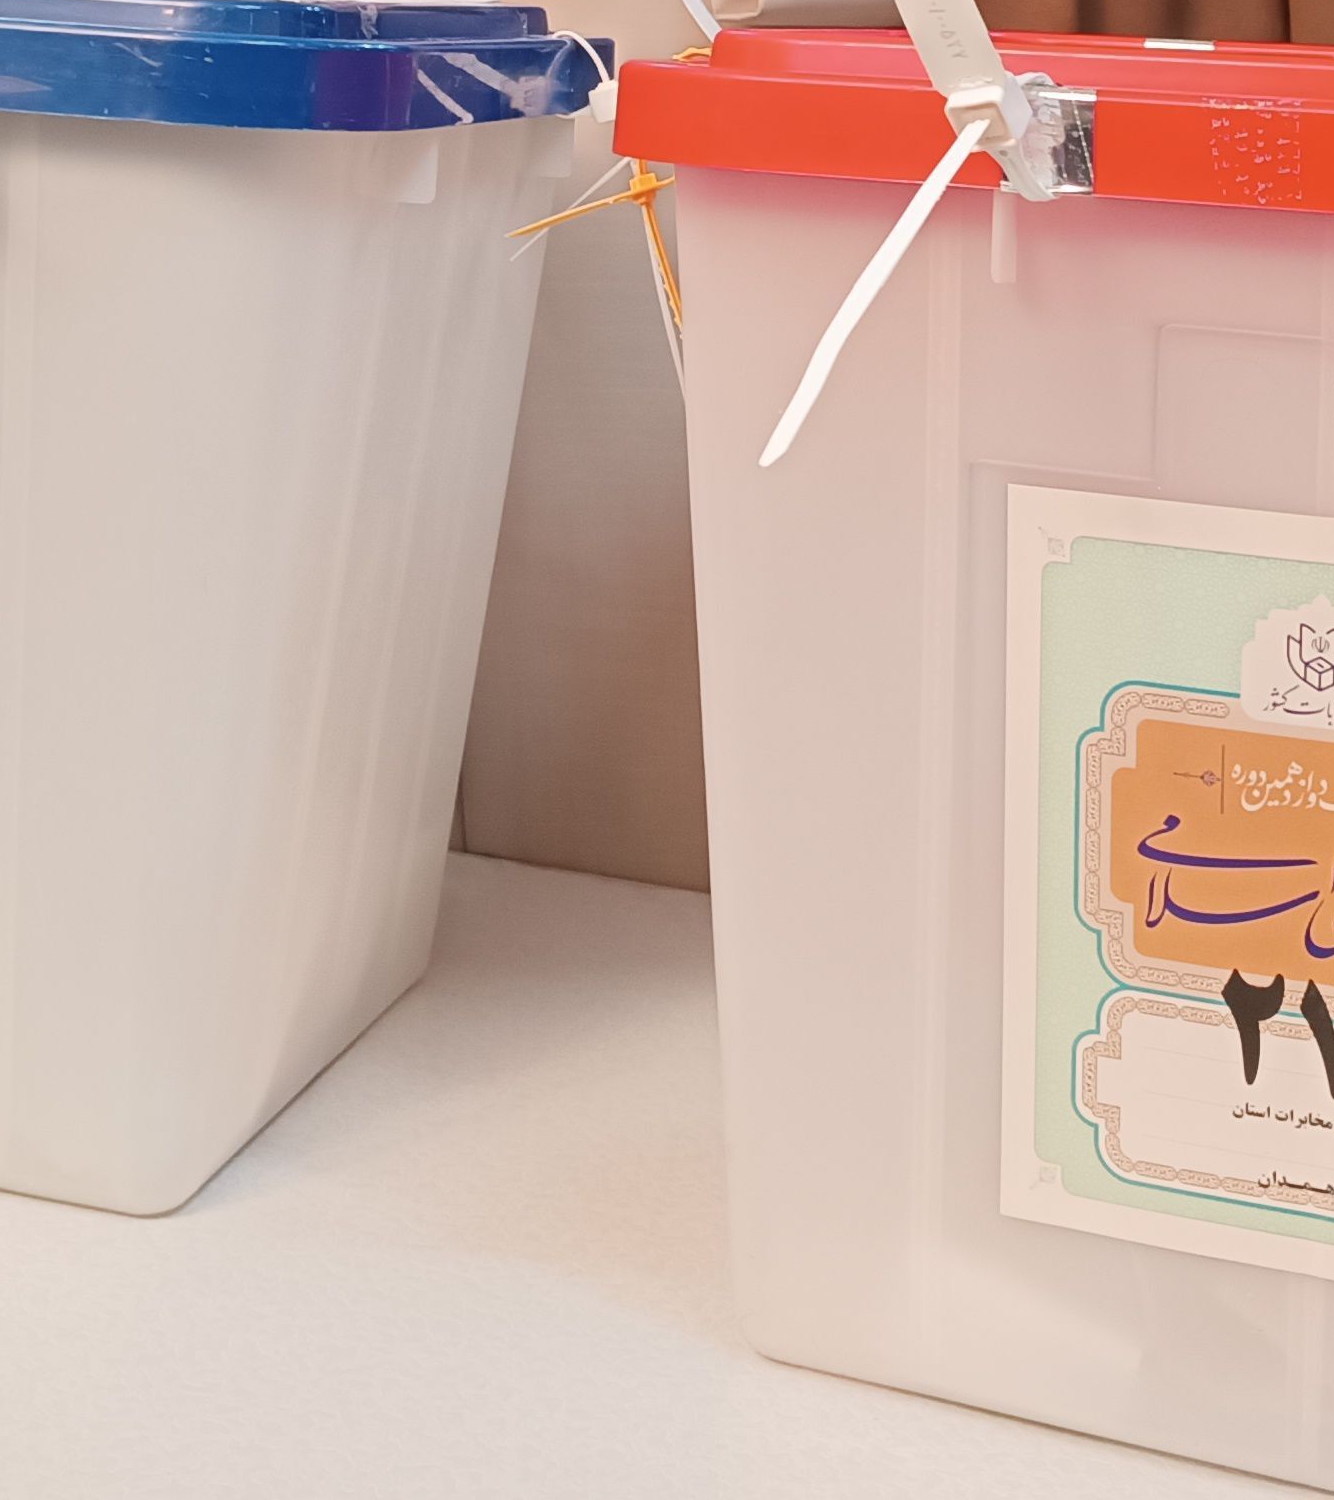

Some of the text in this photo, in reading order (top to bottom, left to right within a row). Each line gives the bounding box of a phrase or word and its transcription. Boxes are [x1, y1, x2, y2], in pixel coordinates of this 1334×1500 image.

[1262, 684, 1300, 712] کشور
[1230, 763, 1267, 787] دوره
[1240, 761, 1328, 812] دوازدهمین
[1232, 1102, 1271, 1118] استان
[1275, 1108, 1334, 1130] مخابرات
